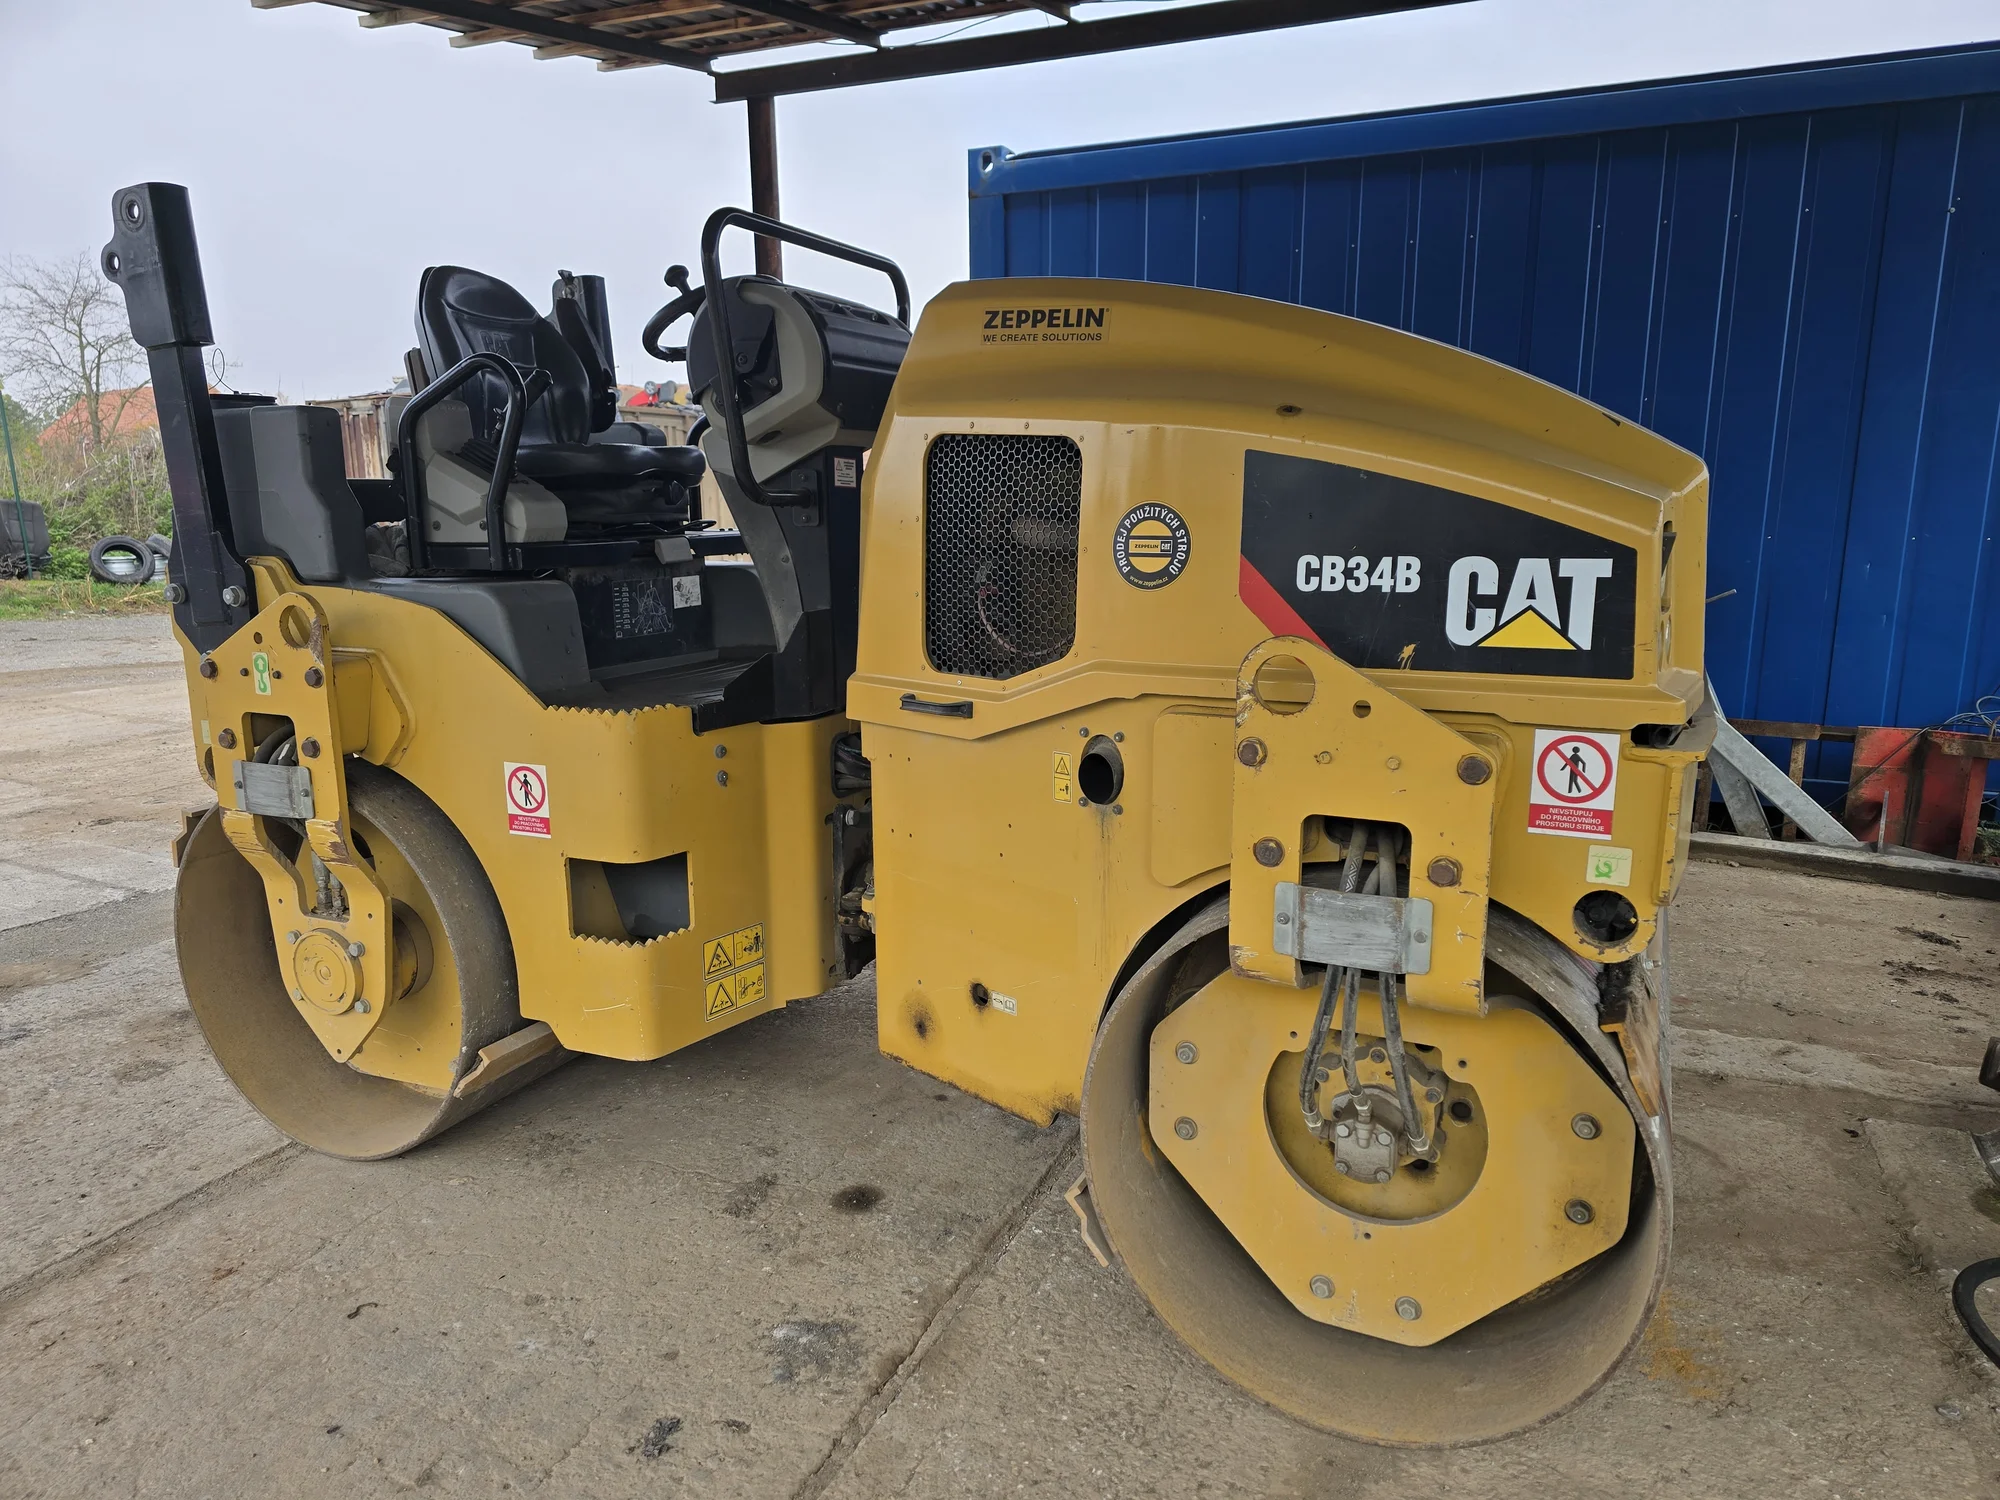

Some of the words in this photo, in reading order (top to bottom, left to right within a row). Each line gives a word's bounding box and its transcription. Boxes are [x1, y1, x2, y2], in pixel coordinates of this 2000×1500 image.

[983, 334, 998, 342] WE
[1000, 333, 1039, 342] CREATE
[1041, 332, 1102, 341] SOLUTIONS
[1123, 505, 1181, 529] POUŽITÝCH
[1116, 528, 1131, 574] PRODEJ
[1168, 529, 1188, 575] STROJŮ
[1129, 575, 1168, 587] www.zeppelin.cz
[1296, 554, 1421, 593] CB34B
[1445, 555, 1614, 651] CAT
[1549, 807, 1593, 817] NEVSTUPUJ
[1553, 814, 1601, 825] PRACOVNÍHO
[1535, 819, 1575, 829] PROSTORU
[1576, 823, 1604, 832] STROJE
